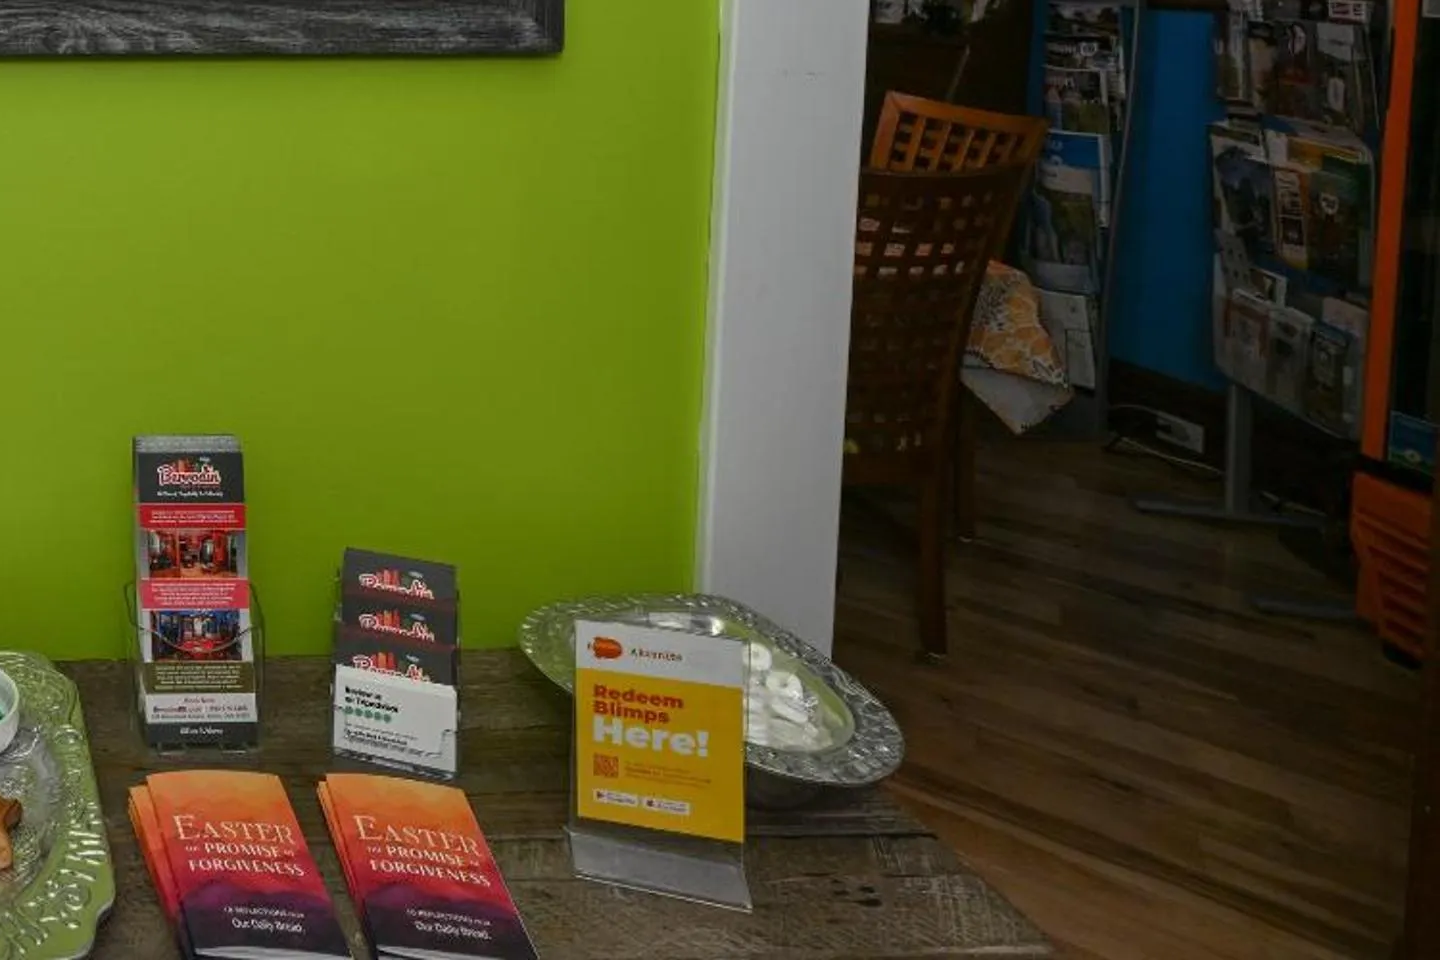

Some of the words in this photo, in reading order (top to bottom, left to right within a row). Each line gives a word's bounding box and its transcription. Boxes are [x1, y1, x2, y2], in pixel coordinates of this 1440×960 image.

[594, 684, 684, 709] Redeem
[594, 700, 670, 725] Blimps
[593, 715, 710, 757] Here!
[204, 842, 280, 858] PROMISE
[385, 844, 464, 866] PROMISE
[188, 858, 305, 877] FORGIVENESS
[369, 859, 491, 887] FORGIVENESS
